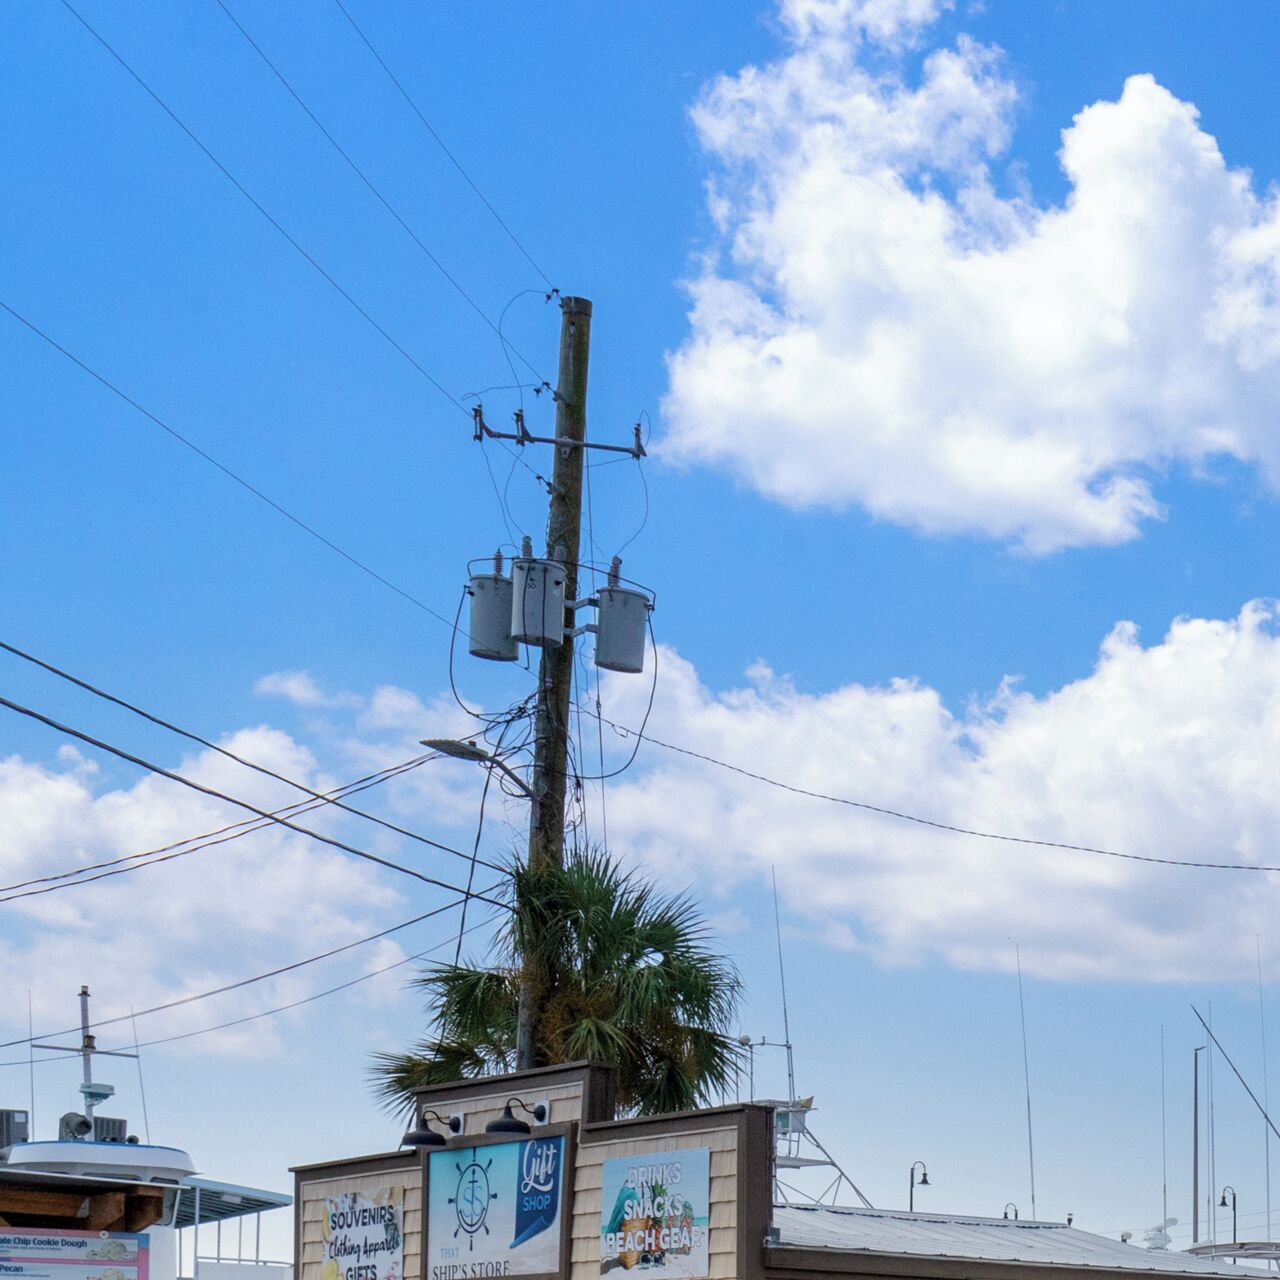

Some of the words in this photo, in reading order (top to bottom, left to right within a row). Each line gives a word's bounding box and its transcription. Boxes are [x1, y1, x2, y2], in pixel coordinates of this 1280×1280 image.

[521, 1140, 557, 1193] Gift
[628, 1161, 681, 1188] DRINKS
[523, 1195, 551, 1211] SHOP
[624, 1194, 683, 1220] SNACKS
[331, 1205, 394, 1231] SOUVENIRS
[13, 1237, 31, 1246] Chip
[32, 1237, 60, 1246] Cookie
[61, 1239, 87, 1248] Dough
[329, 1235, 361, 1263] Clothing
[363, 1235, 400, 1259] Apparel
[440, 1247, 460, 1259] THAT
[606, 1229, 656, 1254] BEACH
[660, 1227, 702, 1249] GEAR
[0, 1264, 23, 1272] Pecan
[433, 1264, 468, 1280] SHIP'S
[470, 1261, 510, 1279] STORE
